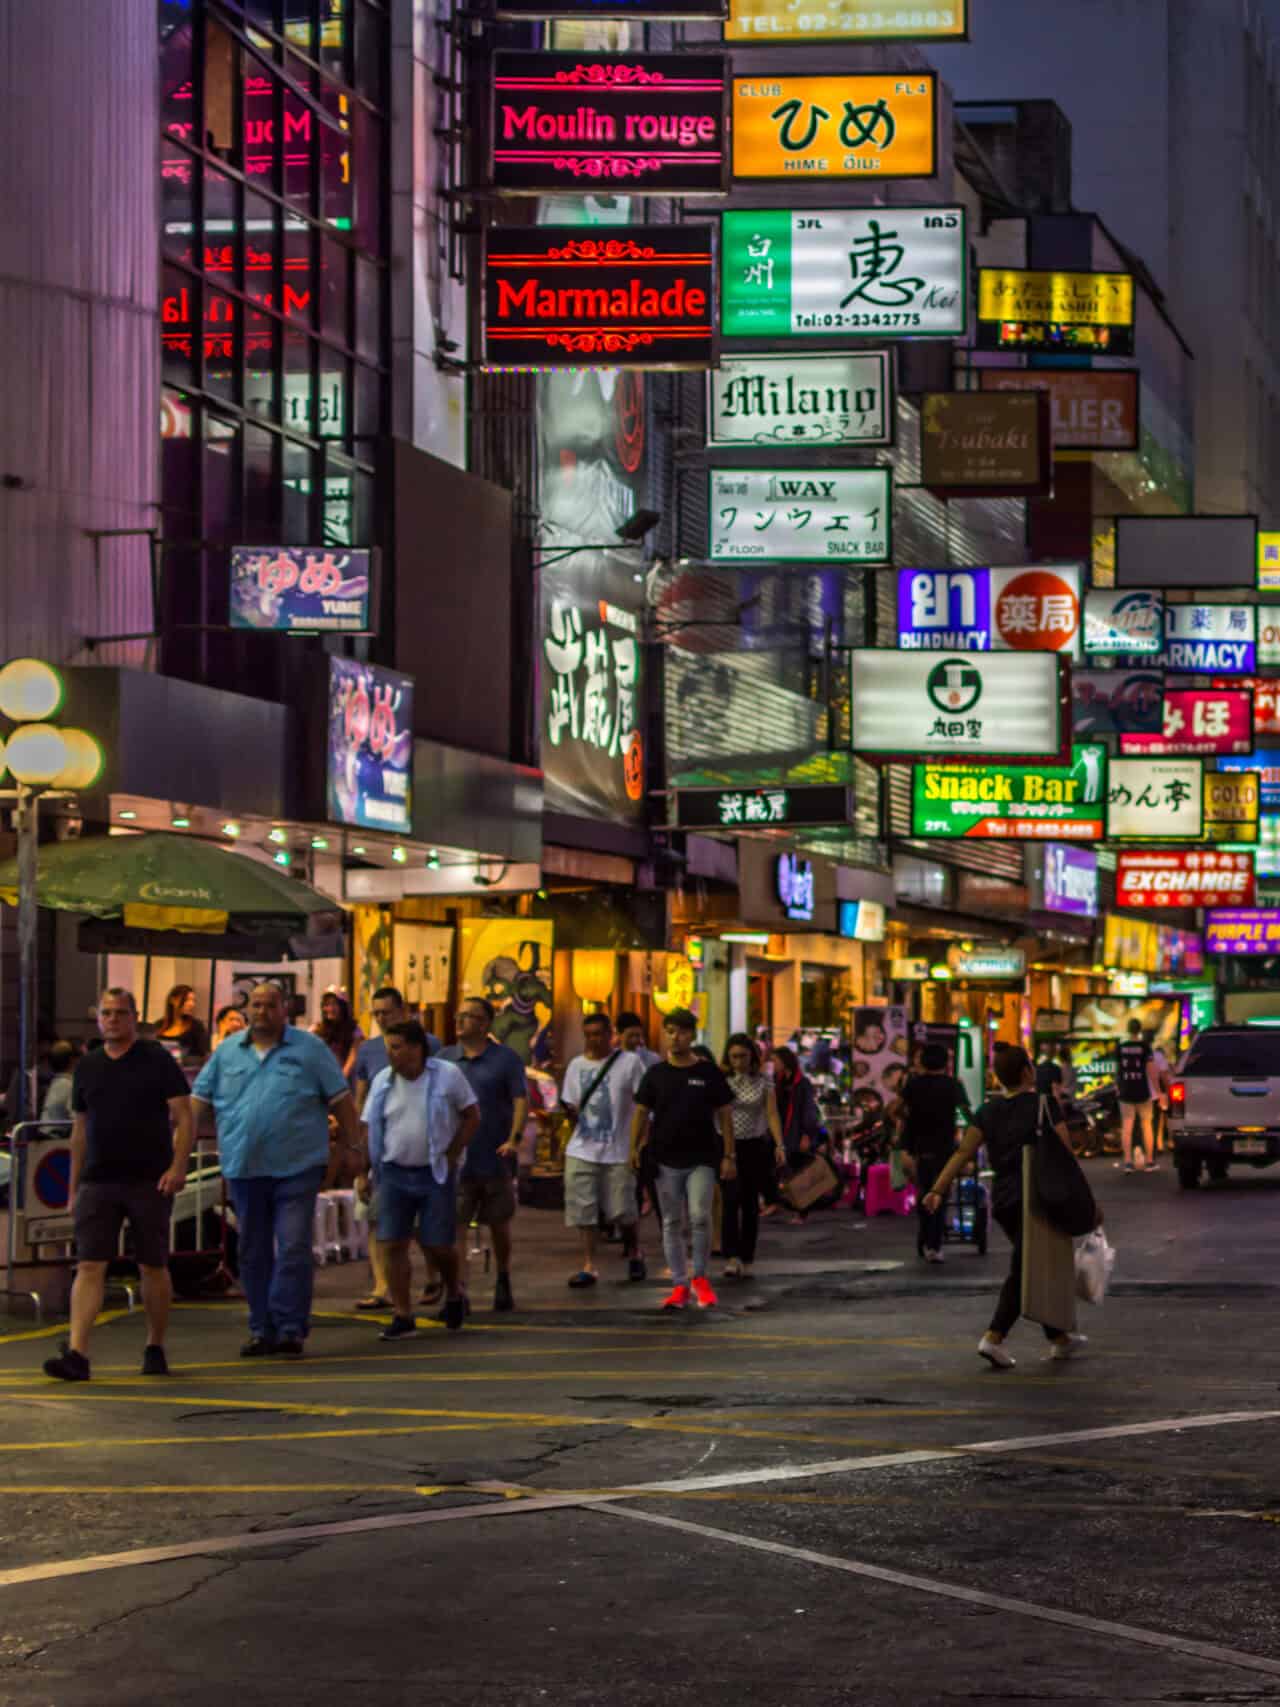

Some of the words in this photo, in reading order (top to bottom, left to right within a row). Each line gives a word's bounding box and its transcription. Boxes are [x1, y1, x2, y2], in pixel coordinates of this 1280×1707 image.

[738, 84, 782, 97] CLUB
[501, 105, 614, 141] Moulin
[625, 114, 717, 146] rouge
[771, 98, 895, 151] ひめ
[784, 159, 828, 171] HIME
[496, 279, 706, 318] Marmalade
[720, 373, 877, 417] Milano
[779, 481, 836, 496] WAY
[719, 507, 881, 532] ワンウェイ
[729, 546, 765, 554] FLOOR
[827, 542, 859, 554] SNACK
[865, 542, 885, 554] BAR
[257, 551, 343, 595] ゆめ
[911, 572, 976, 628] ยา
[1001, 594, 1076, 633] 薬局
[924, 773, 1013, 801] Snack
[1023, 775, 1079, 802] Bar
[1107, 779, 1192, 813] めん亭
[1211, 785, 1256, 804] GOLD
[1122, 870, 1250, 891] EXCHANGE
[1207, 923, 1263, 940] PURPLE
